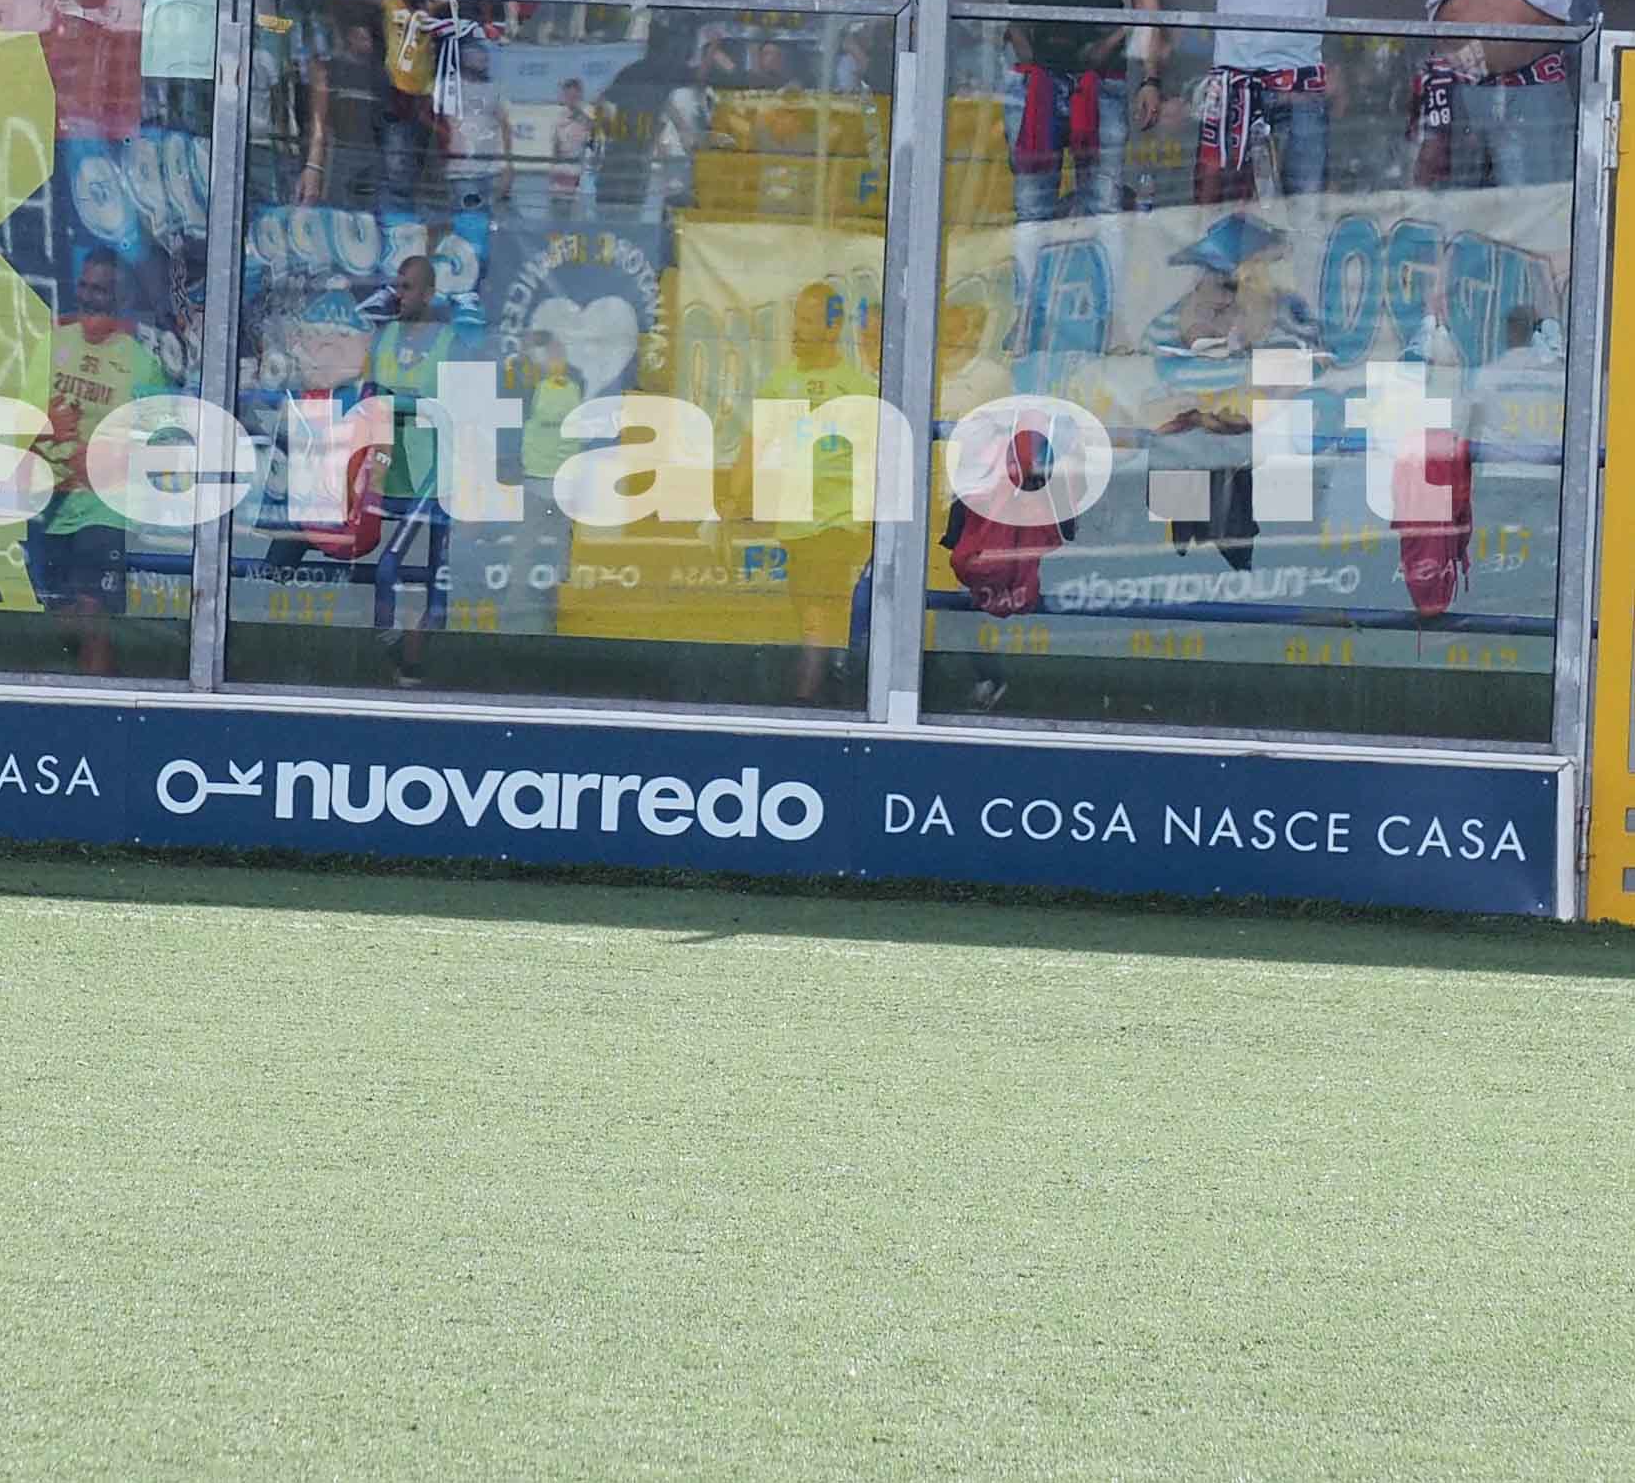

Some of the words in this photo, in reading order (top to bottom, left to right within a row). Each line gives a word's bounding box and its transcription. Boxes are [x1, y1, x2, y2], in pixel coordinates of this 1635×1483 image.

[275, 759, 825, 842] nuovarredo
[884, 793, 955, 836] DA
[980, 797, 1137, 847] COSA
[1164, 806, 1351, 853] NASCE
[1376, 815, 1527, 862] CASA
